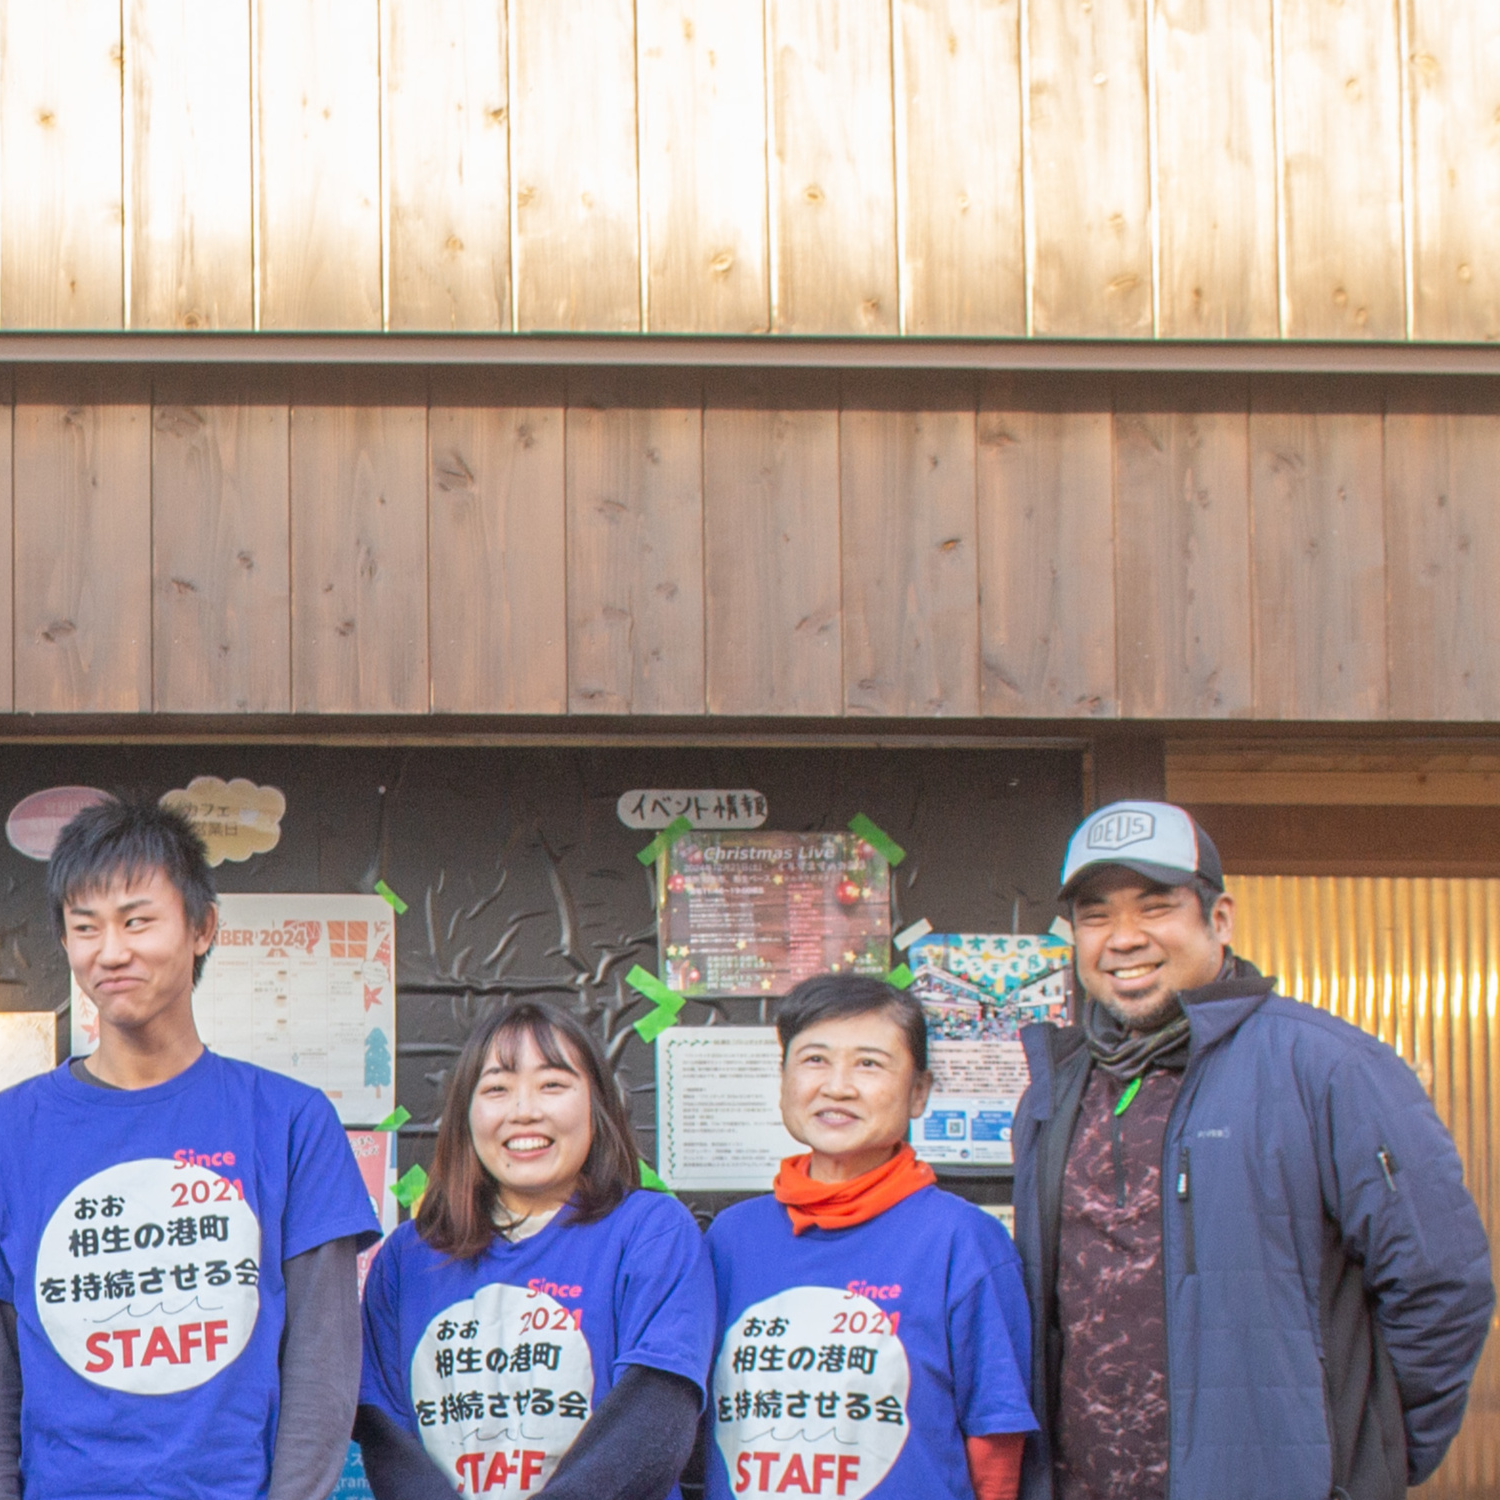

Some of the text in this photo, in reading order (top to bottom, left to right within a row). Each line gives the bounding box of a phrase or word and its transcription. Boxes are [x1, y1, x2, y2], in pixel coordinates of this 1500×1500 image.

[1093, 815, 1144, 843] DEUS
[703, 846, 836, 862] Christmas Live
[260, 929, 307, 947] 2024
[172, 1149, 236, 1170] Since
[170, 1177, 244, 1208] 2021
[74, 1194, 126, 1220] おお
[68, 1214, 230, 1258] 相生の港町
[40, 1257, 260, 1304] を持続させる会
[526, 1278, 582, 1299] Since
[843, 1280, 902, 1300] Since
[436, 1320, 480, 1341] おお
[518, 1307, 583, 1336] 2021
[743, 1316, 790, 1337] おお
[829, 1310, 900, 1336] 2021
[84, 1319, 228, 1374] STAFF
[435, 1342, 563, 1379] 相生の港町
[732, 1344, 878, 1375] 相生の港町
[415, 1388, 588, 1426] を持続させる会
[718, 1389, 904, 1426] を持続させる会
[735, 1451, 860, 1496] STAFF
